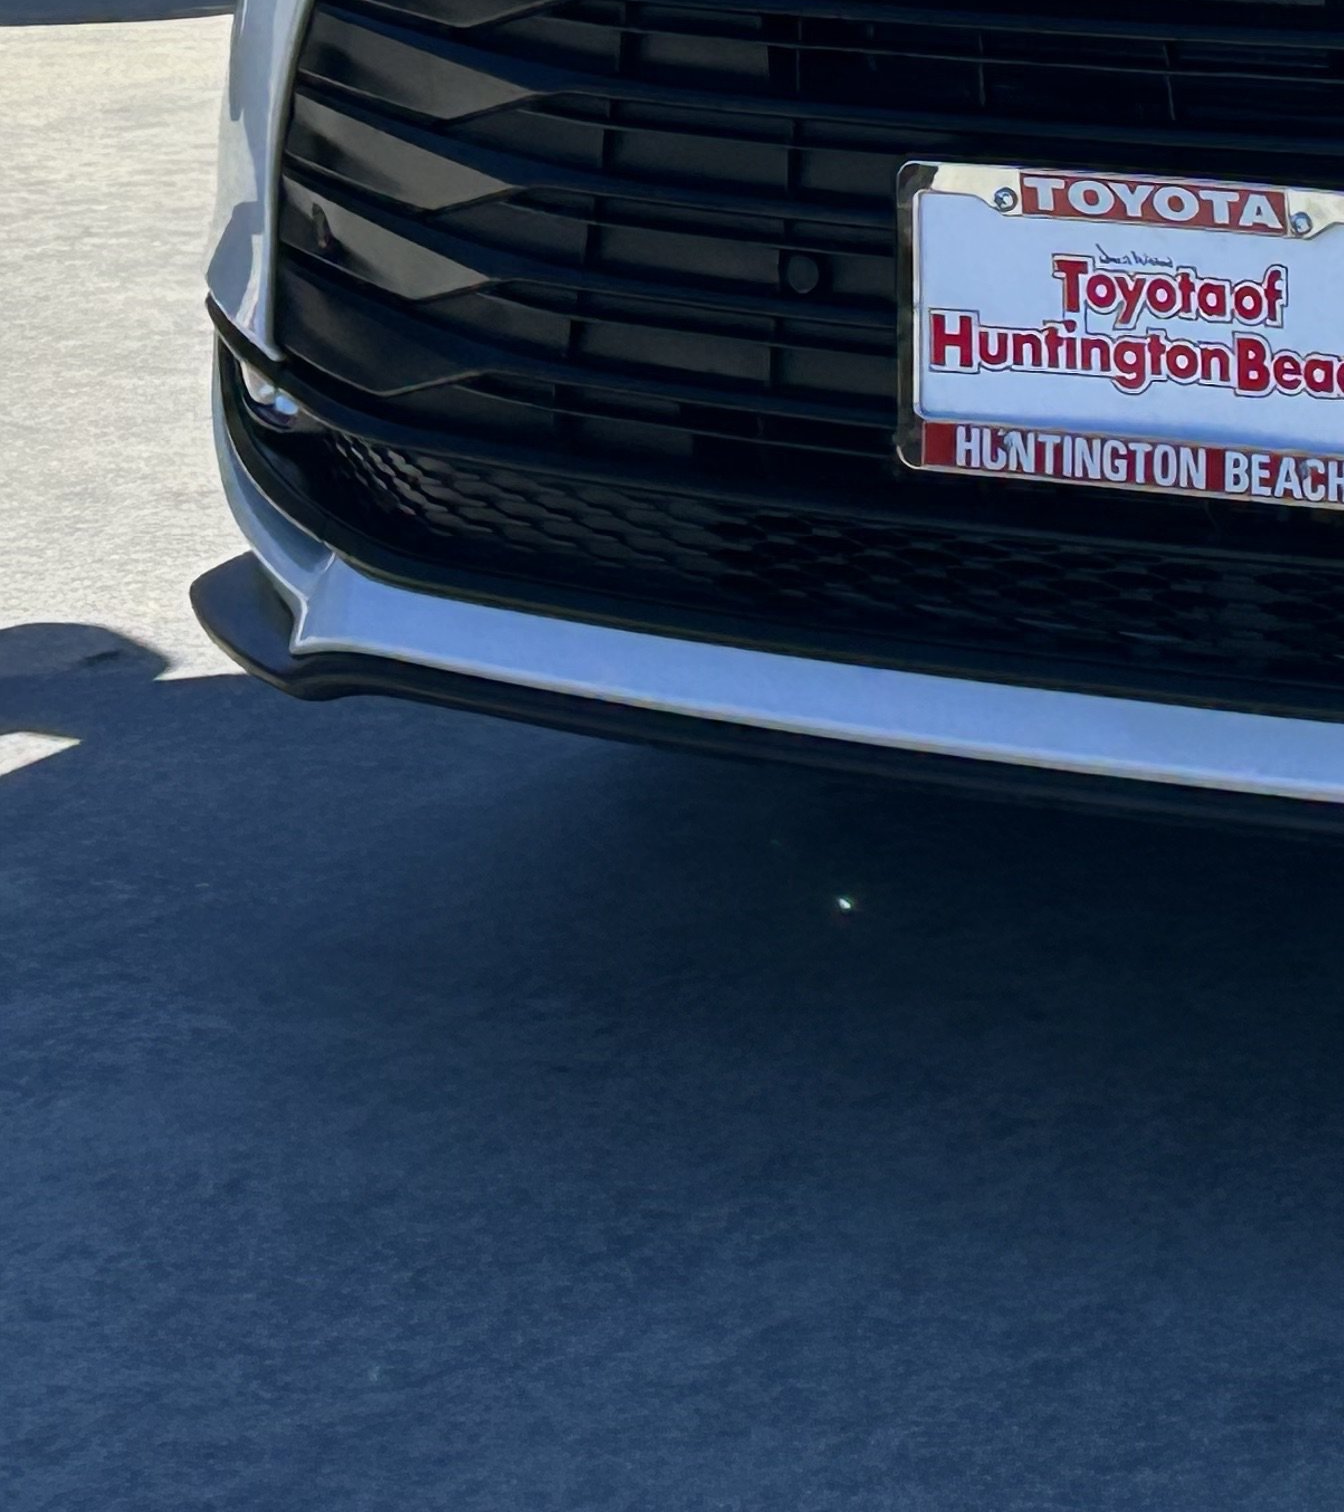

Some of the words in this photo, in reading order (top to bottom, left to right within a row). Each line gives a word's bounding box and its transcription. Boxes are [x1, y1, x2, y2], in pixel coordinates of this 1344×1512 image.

[1022, 176, 1284, 230] TOYOTA
[1053, 258, 1228, 324] Toyota
[1233, 269, 1283, 322] of
[929, 312, 1231, 386] Huntington
[956, 426, 1207, 489] HUNTINGTON
